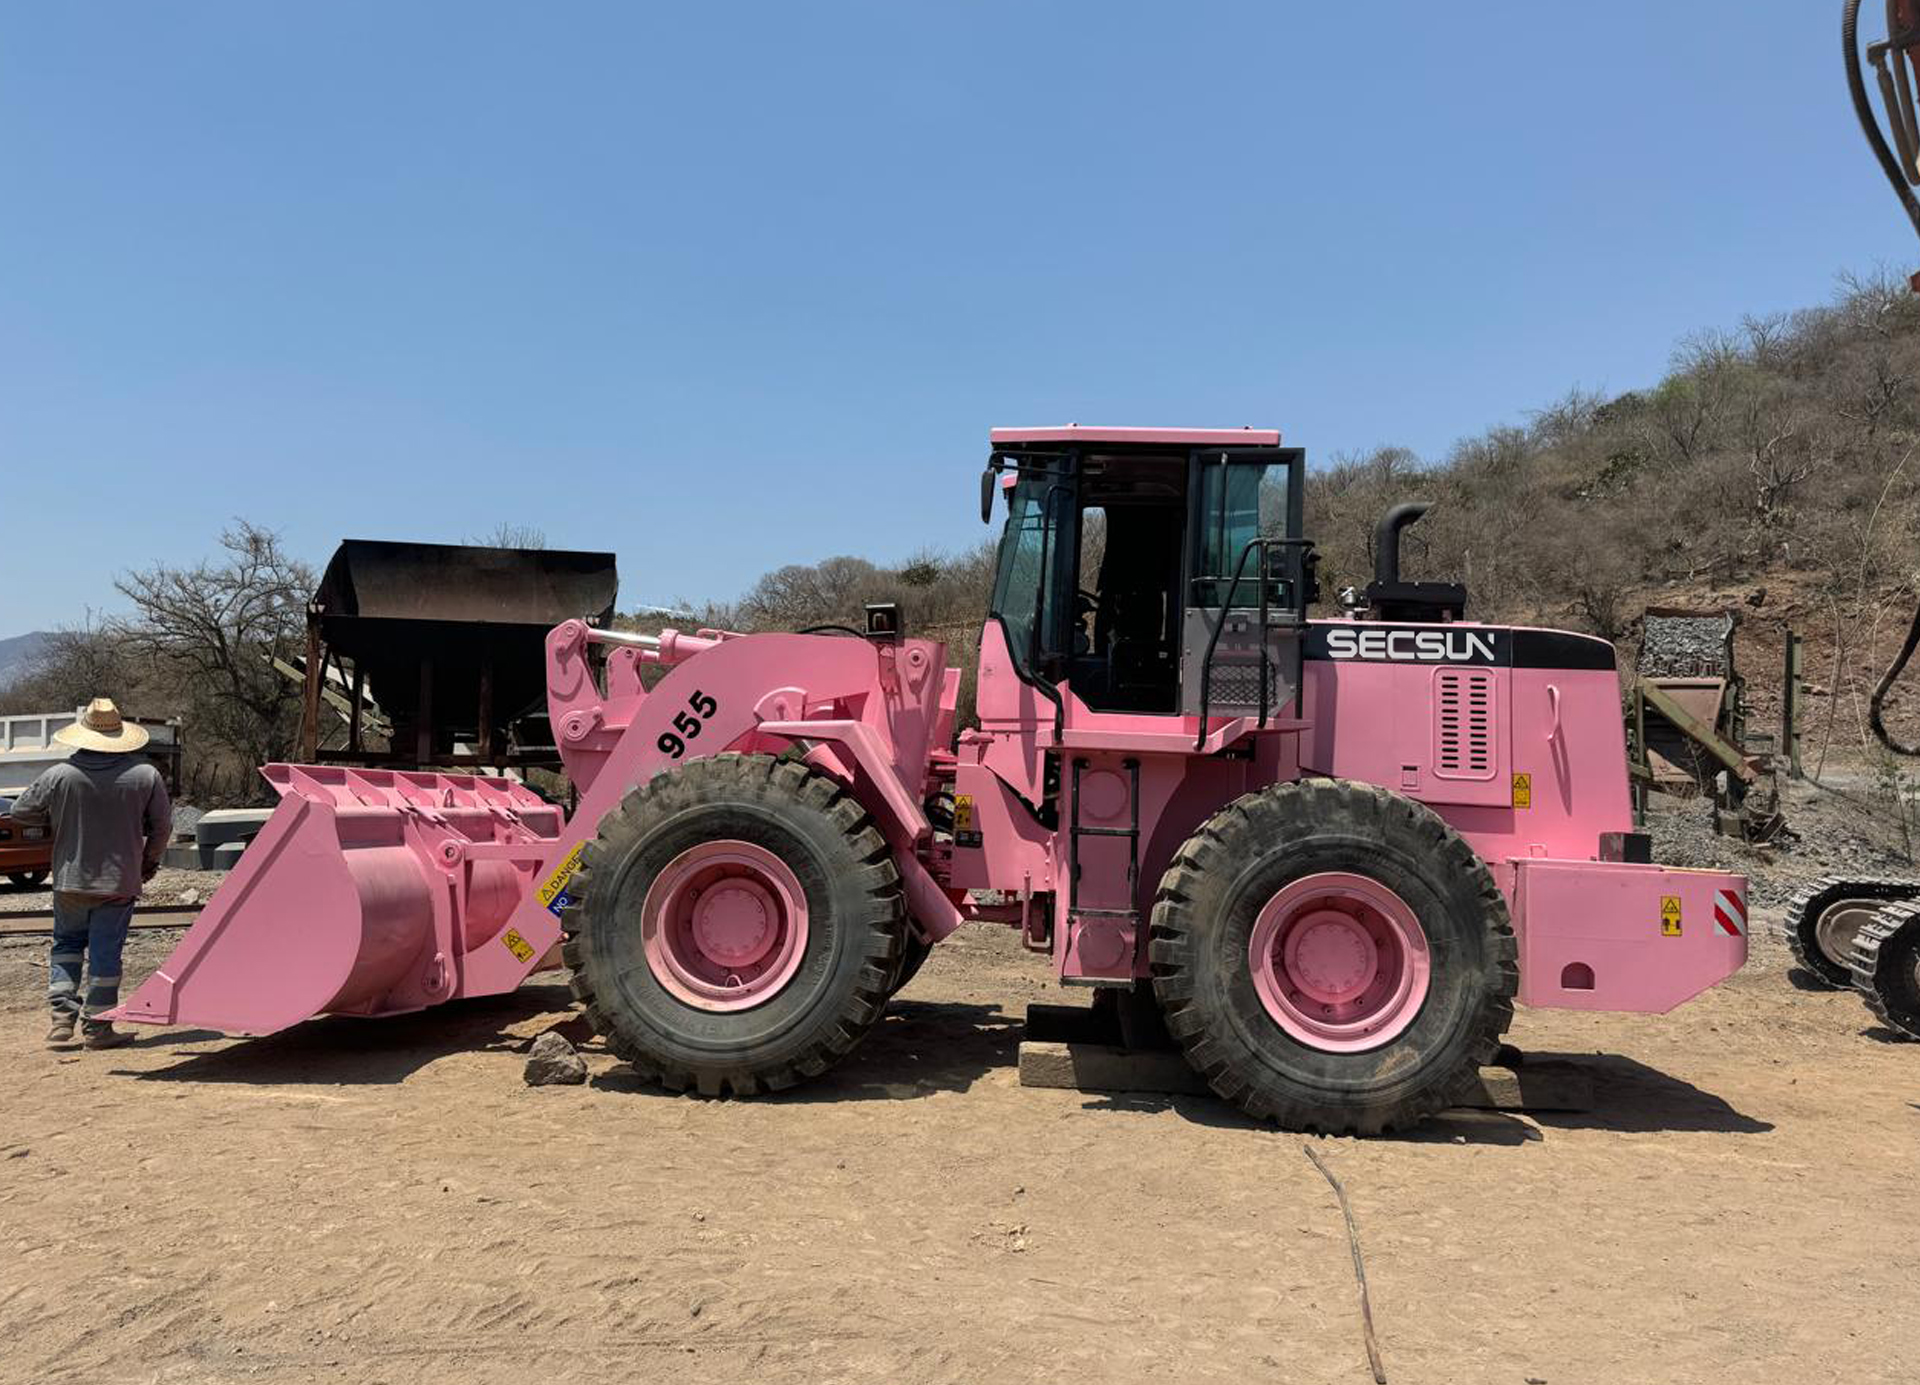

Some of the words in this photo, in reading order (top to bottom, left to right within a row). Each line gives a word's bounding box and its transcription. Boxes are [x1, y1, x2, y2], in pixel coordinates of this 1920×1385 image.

[1326, 629, 1495, 661] SECSUN
[657, 689, 717, 759] 955
[550, 849, 581, 890] DANGE
[553, 896, 568, 912] NO
